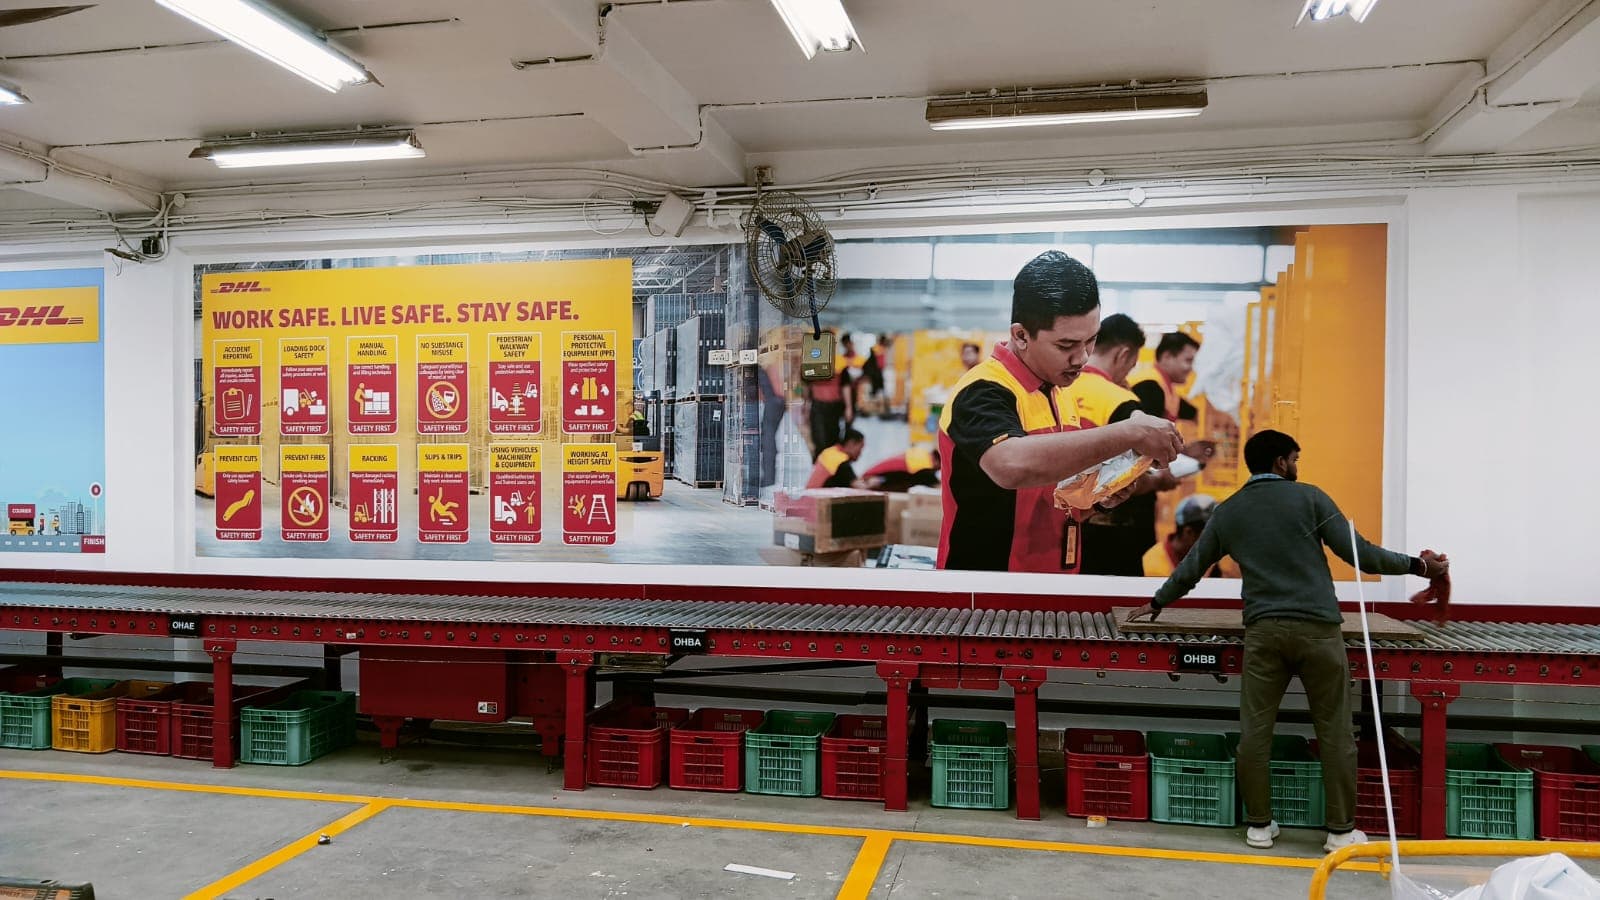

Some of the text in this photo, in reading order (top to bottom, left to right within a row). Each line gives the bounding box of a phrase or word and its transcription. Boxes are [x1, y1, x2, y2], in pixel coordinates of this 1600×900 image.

[217, 281, 263, 294] DHL
[0, 306, 69, 326] DHL
[212, 301, 579, 329] WORK SAFE. LIVE SAFE. STAY SAFE.
[496, 335, 533, 343] PEDESTRIAN
[563, 350, 598, 358] EQUIPMENT
[353, 424, 391, 432] SAFETY FIRST
[423, 424, 461, 432] SAFETY FIRST
[568, 423, 609, 431] SAFETY FIRST
[83, 537, 105, 545] FINISH
[568, 535, 609, 543] SAFETY FIRST
[172, 621, 195, 630] OHAE
[674, 637, 702, 647] OHBA
[1183, 654, 1216, 664] OHBB
